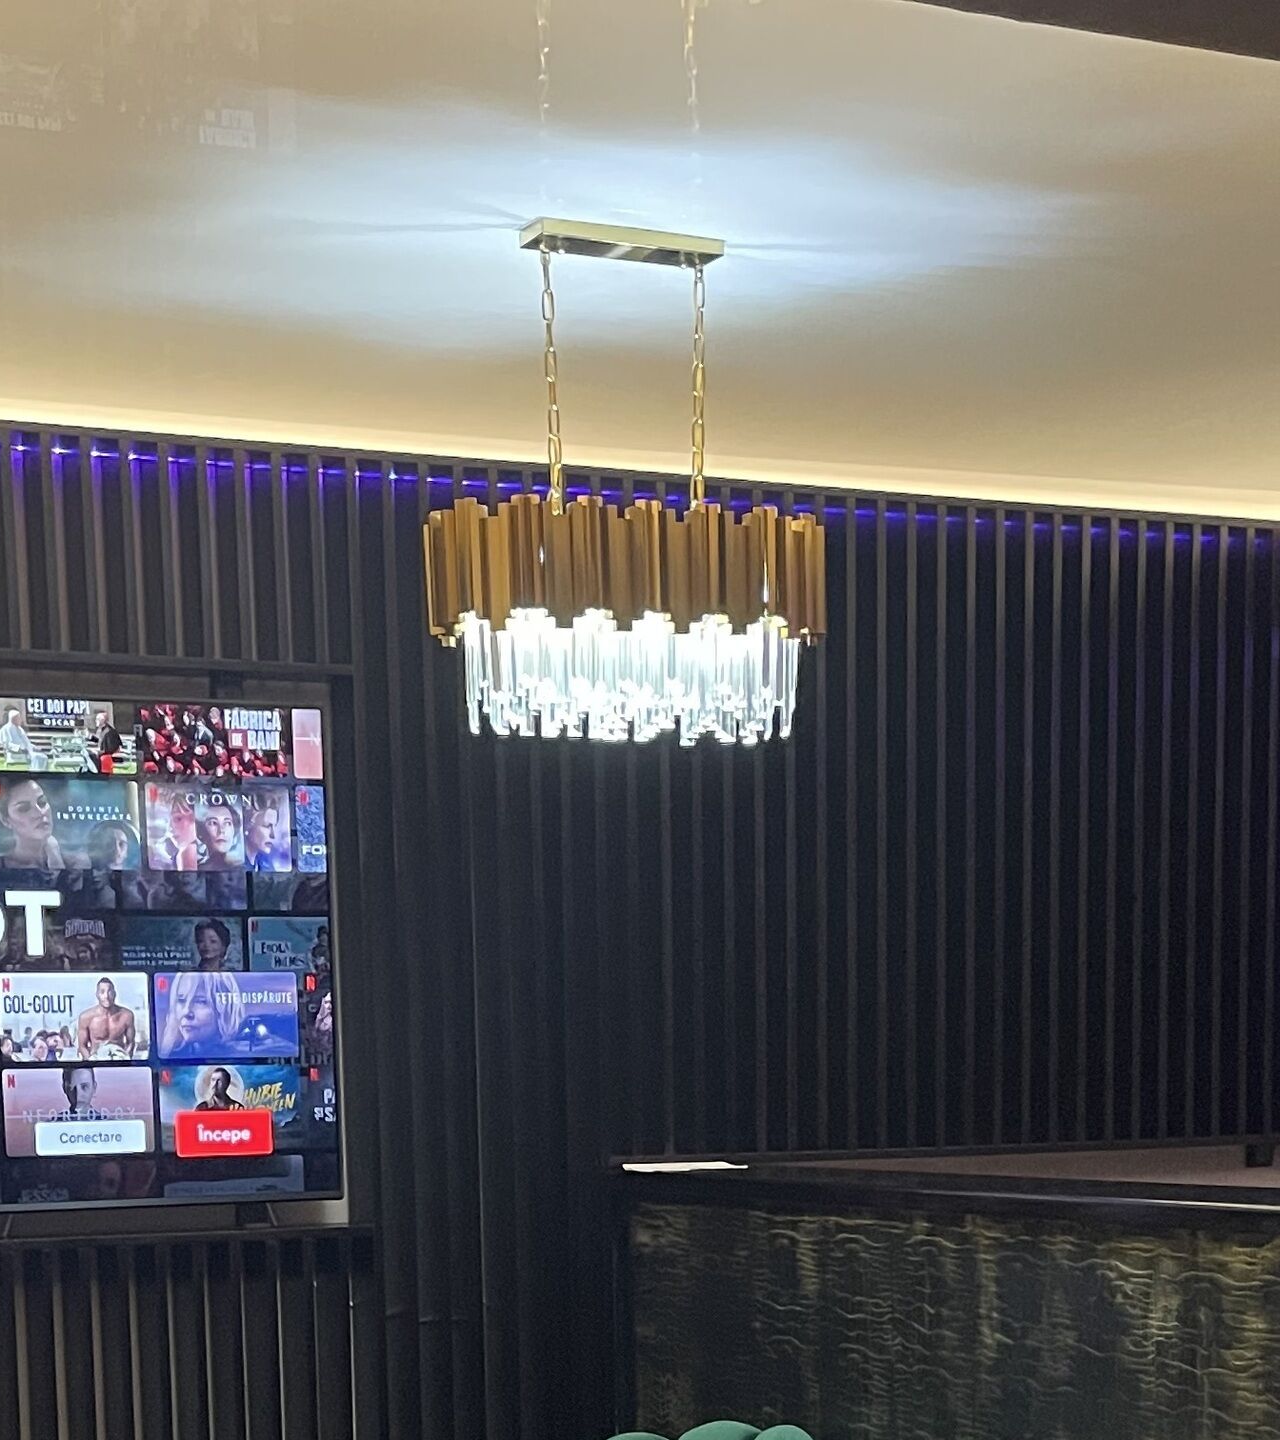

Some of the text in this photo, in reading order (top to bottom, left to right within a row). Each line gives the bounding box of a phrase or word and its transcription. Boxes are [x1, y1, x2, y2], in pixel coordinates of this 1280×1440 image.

[27, 698, 90, 715] CEI DOI PAPI
[43, 718, 76, 726] OSCAR
[223, 708, 282, 731] FABRICA
[185, 793, 252, 806] CROWN
[59, 1132, 123, 1144] Conectare
[197, 1123, 251, 1144] Începe
